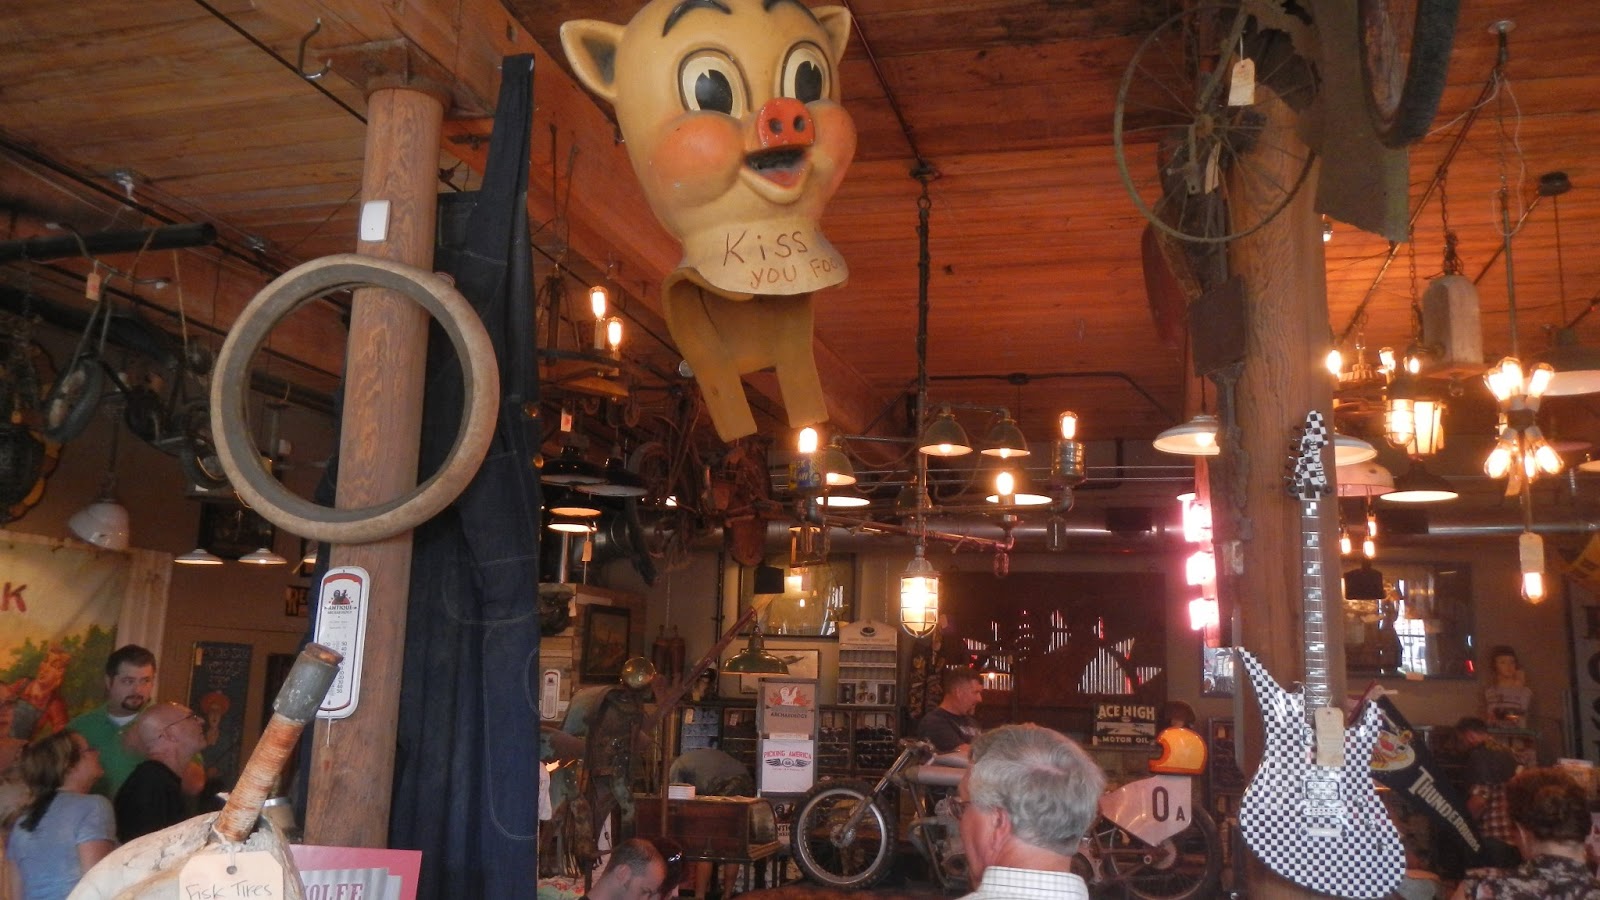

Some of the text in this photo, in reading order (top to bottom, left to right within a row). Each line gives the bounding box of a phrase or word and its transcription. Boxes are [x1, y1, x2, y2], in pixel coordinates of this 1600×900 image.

[0, 582, 27, 612] K
[1097, 705, 1155, 721] ACE HIGH
[764, 750, 812, 760] PICKING AMERICA
[1175, 805, 1186, 821] A
[304, 884, 364, 900] OLFE
